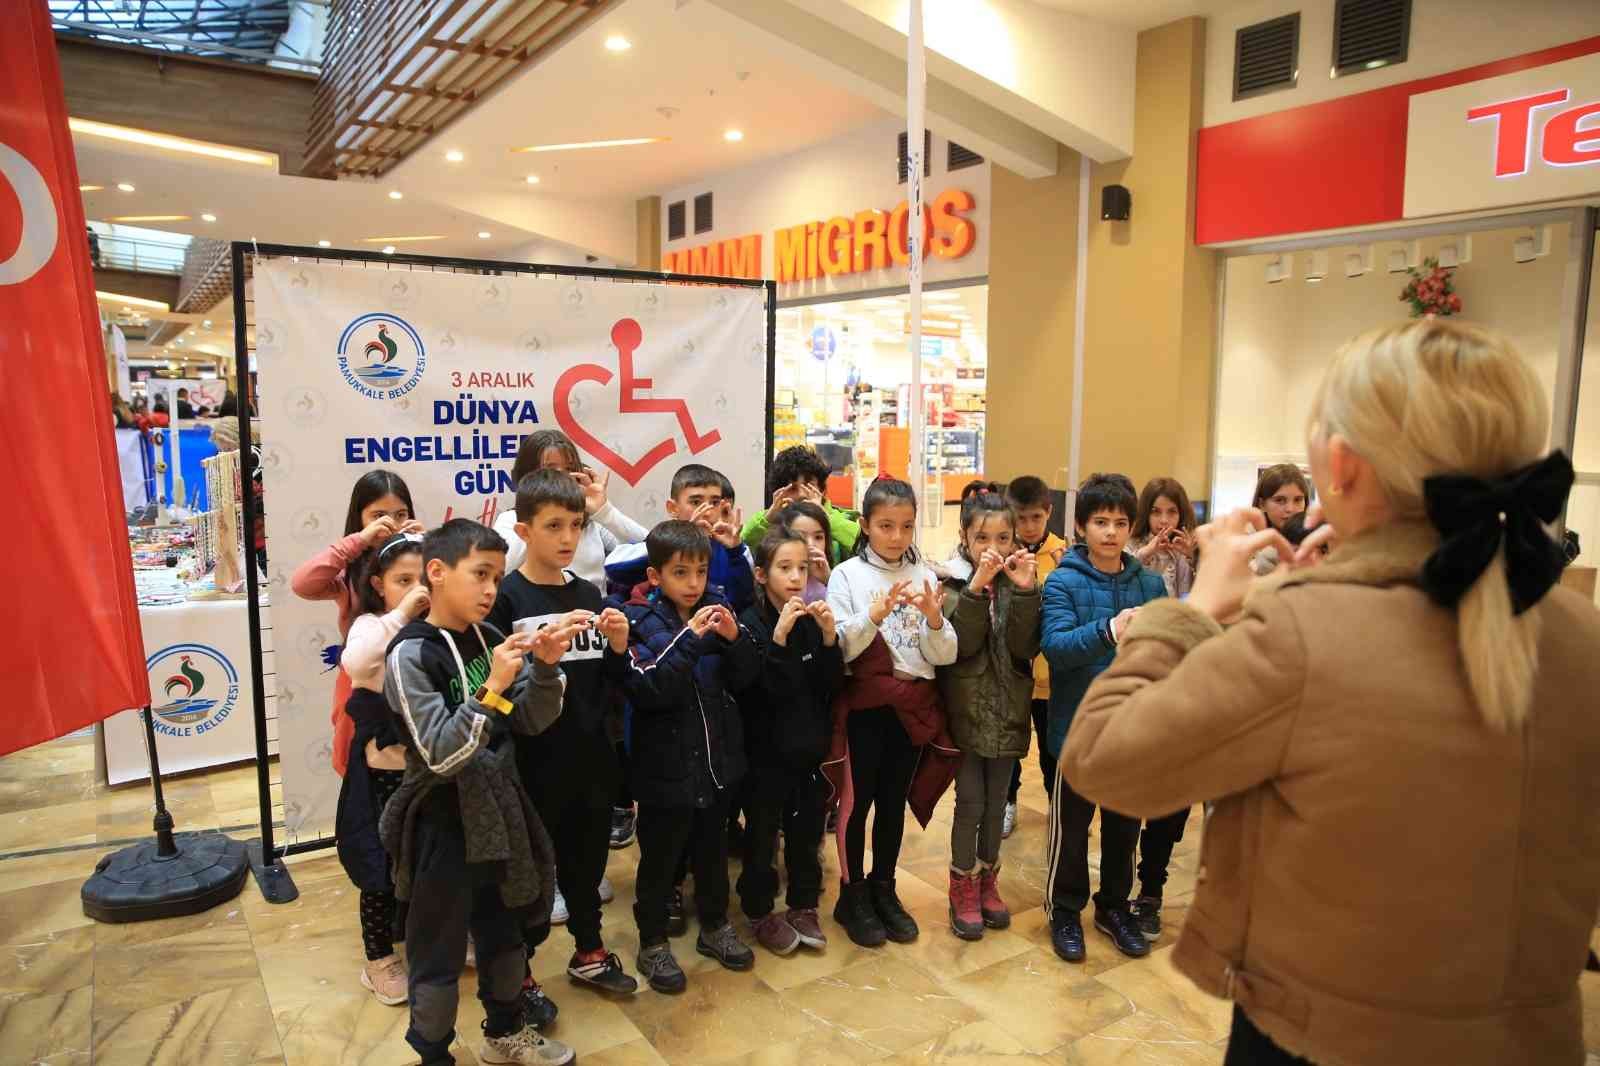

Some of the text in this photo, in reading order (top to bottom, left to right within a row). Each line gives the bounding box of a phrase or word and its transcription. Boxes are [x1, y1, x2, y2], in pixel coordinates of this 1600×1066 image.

[337, 356, 385, 400] PAMUKKALE
[451, 372, 535, 388] 3 ARALIK
[433, 393, 539, 425] DÜNYA
[454, 463, 517, 496] GÜN
